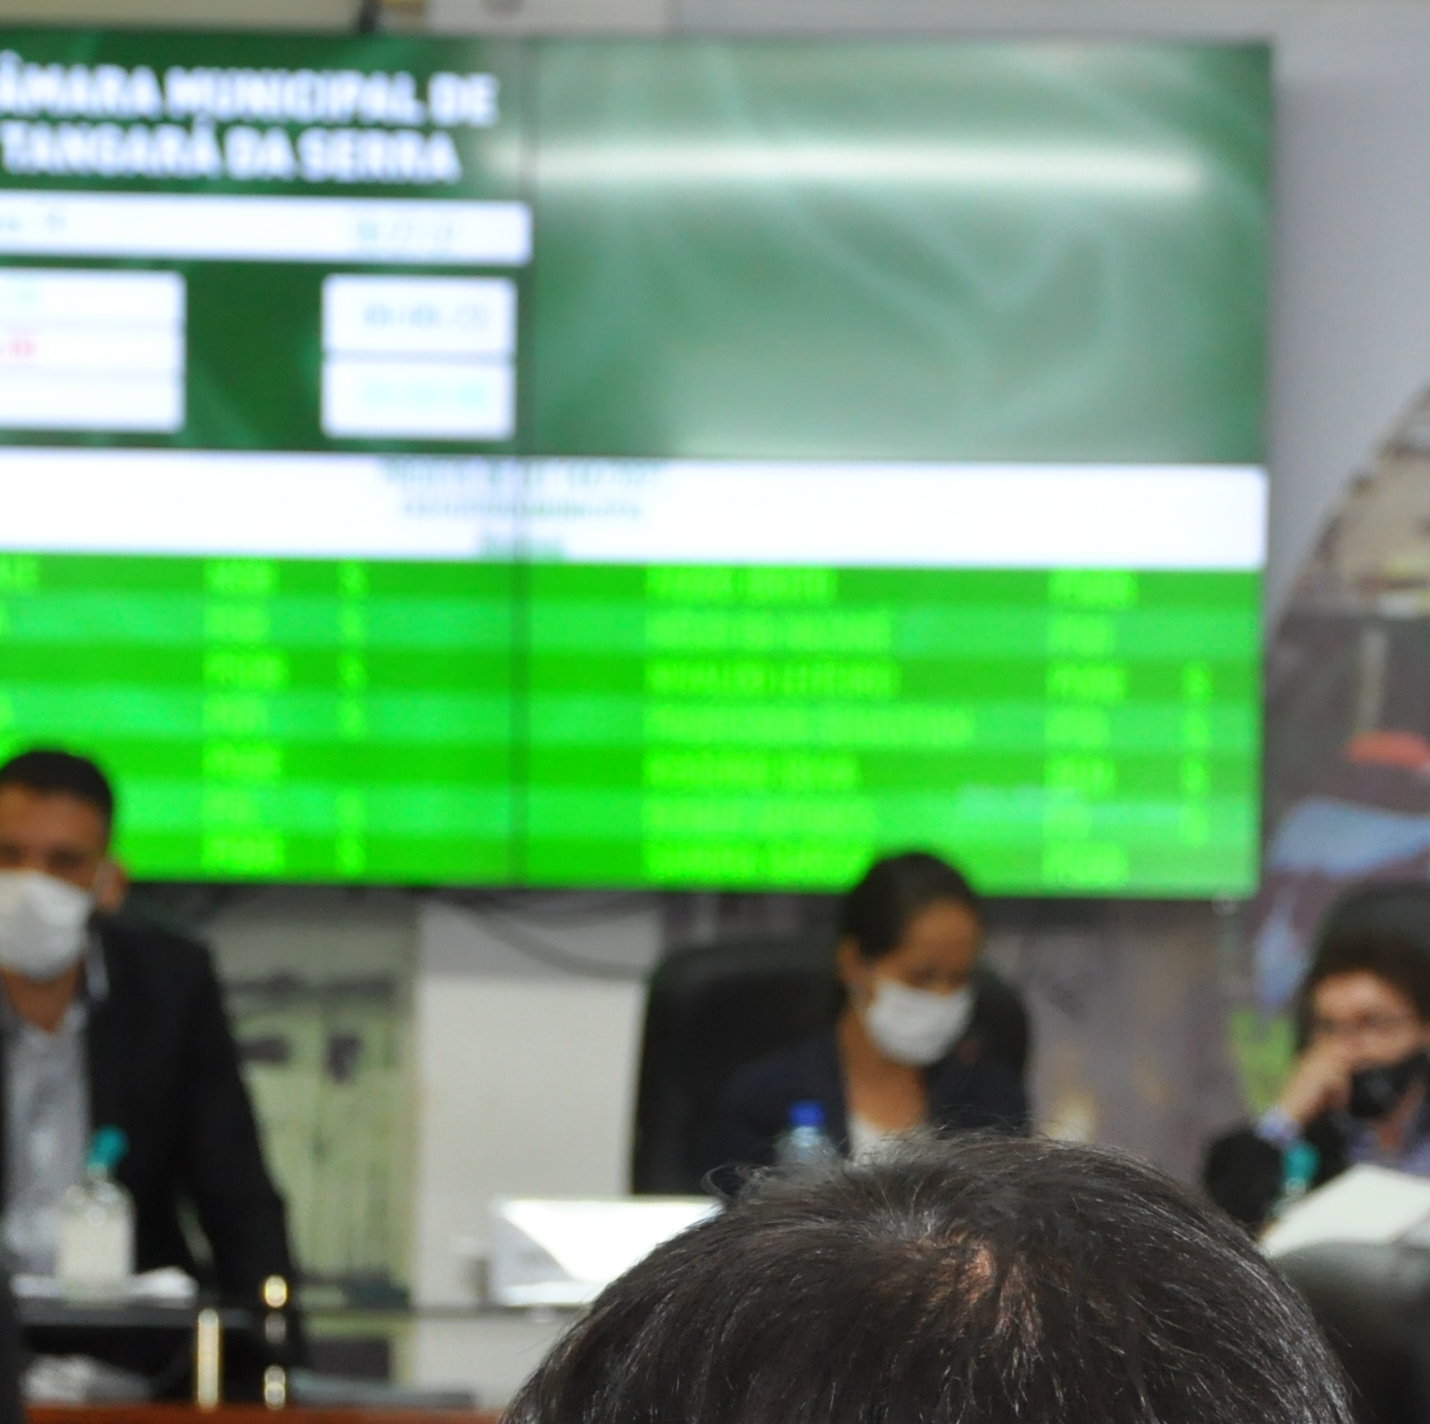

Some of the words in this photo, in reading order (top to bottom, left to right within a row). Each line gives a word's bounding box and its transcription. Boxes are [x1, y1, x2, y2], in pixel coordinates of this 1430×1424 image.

[165, 67, 426, 126] MUNICIPAL
[428, 71, 500, 127] DE
[224, 125, 297, 180] DA
[297, 127, 463, 185] SERRA
